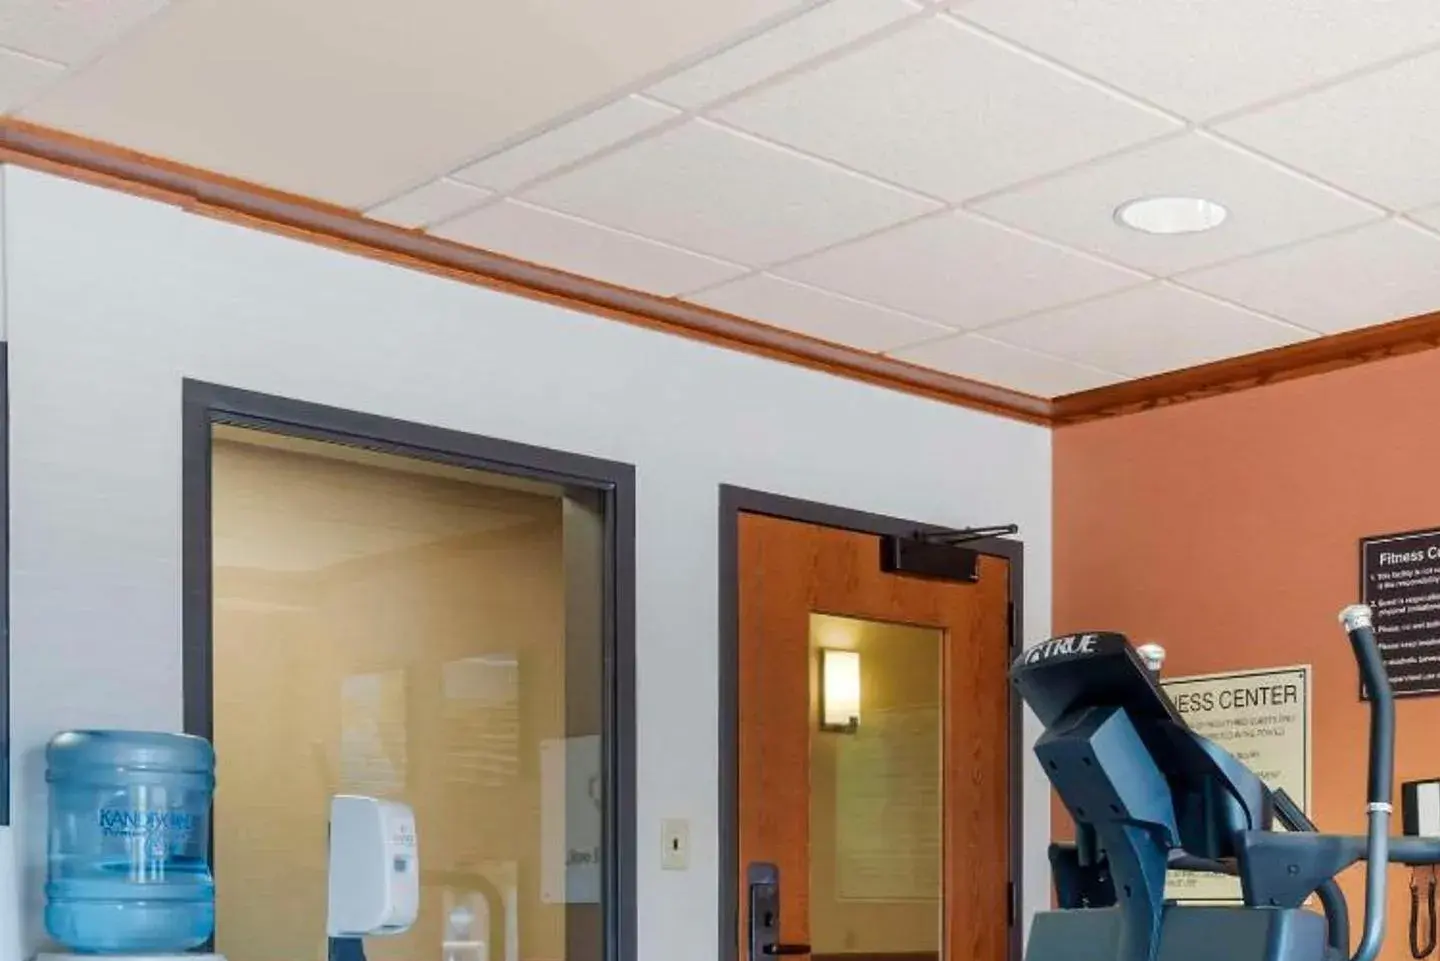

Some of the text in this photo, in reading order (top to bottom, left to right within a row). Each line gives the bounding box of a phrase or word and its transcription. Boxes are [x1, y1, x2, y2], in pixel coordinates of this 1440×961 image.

[1379, 550, 1424, 566] Fitness
[1043, 633, 1098, 660] TRUE
[1174, 685, 1298, 713] ESS CENTER
